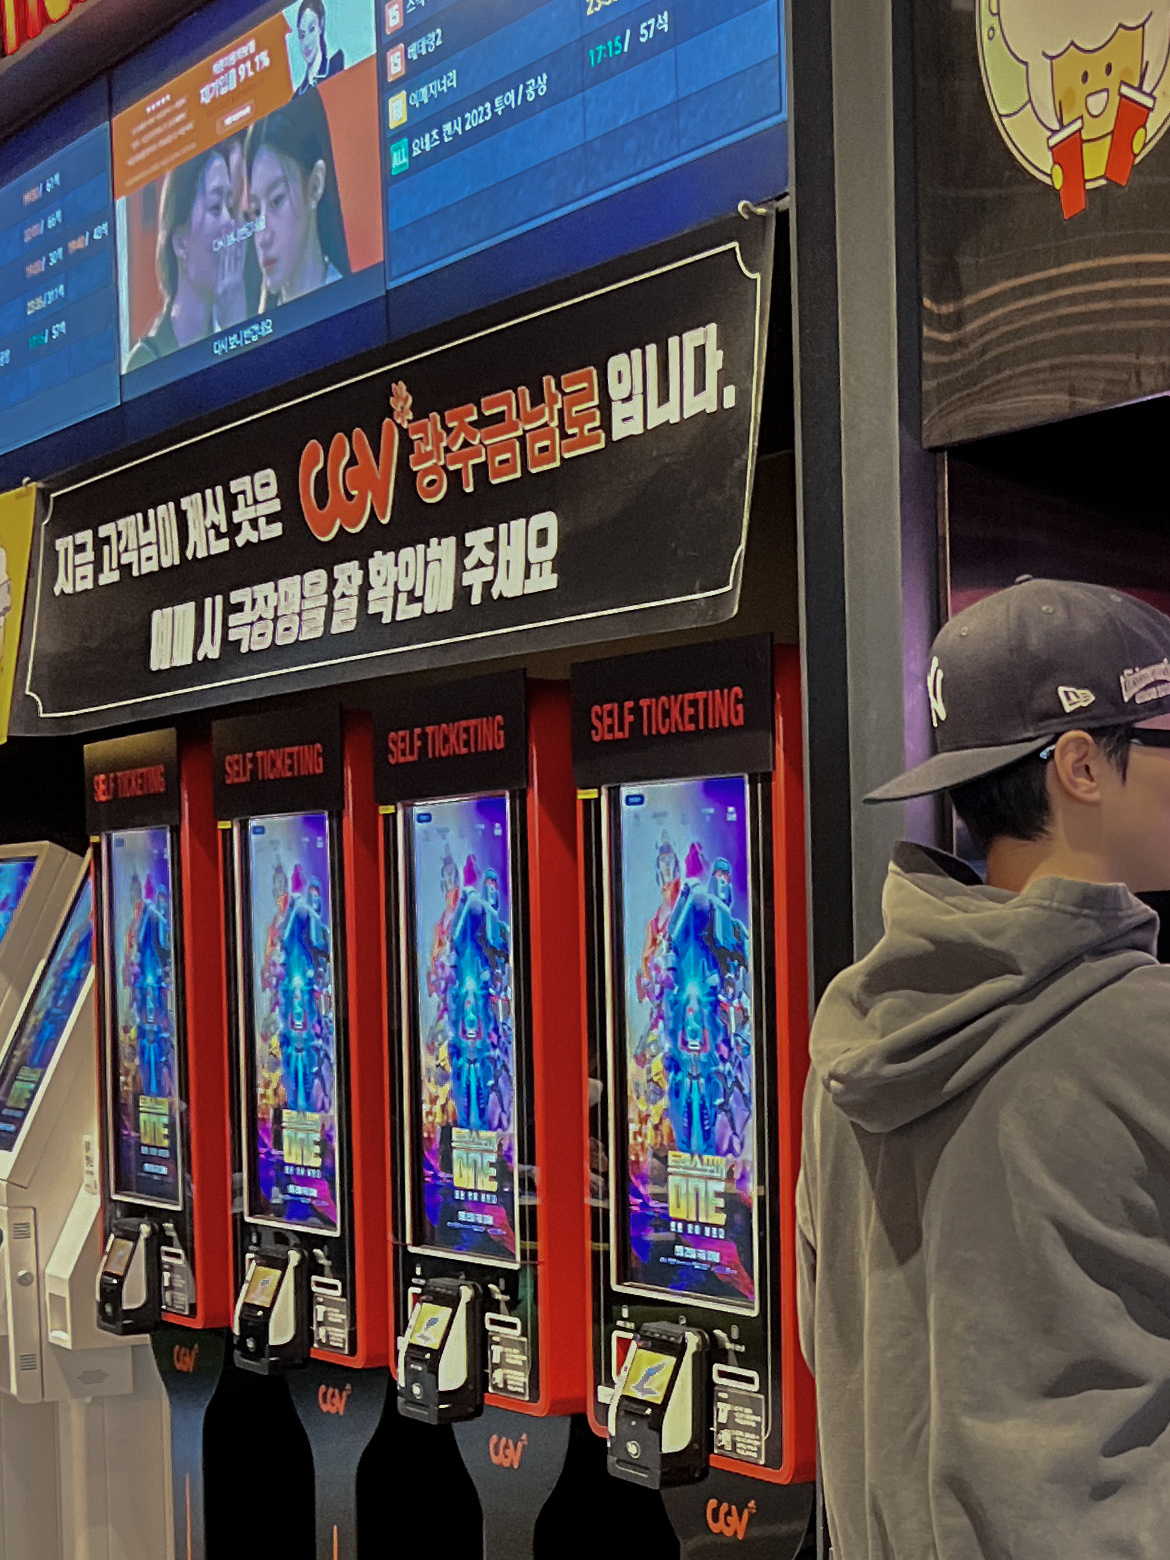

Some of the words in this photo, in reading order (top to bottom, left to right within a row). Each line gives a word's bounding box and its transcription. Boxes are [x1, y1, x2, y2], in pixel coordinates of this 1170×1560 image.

[639, 10, 669, 43] 57석
[411, 128, 441, 158] 요네즈
[464, 101, 492, 131] 2023
[493, 88, 516, 116] 투어
[525, 72, 548, 102] 공상
[53, 528, 95, 597] 지금
[98, 502, 180, 586] 고객님이
[180, 485, 230, 561] 계신
[230, 468, 283, 548] 곳은
[299, 416, 399, 542] CGV
[407, 365, 605, 504] 광주금남로
[607, 322, 736, 442] 입니다.
[197, 594, 224, 661] 시
[228, 568, 329, 654] 극장명을
[330, 560, 364, 635] 잘
[367, 535, 456, 625] 확인해
[462, 510, 558, 605] 주세요
[388, 729, 423, 765] SELF
[424, 714, 506, 757] TICKETING
[591, 701, 635, 742] SELF
[638, 685, 745, 736] TICKETING
[225, 752, 251, 785] SELF
[255, 743, 324, 780] TICKETING
[706, 1498, 749, 1541] CGV
